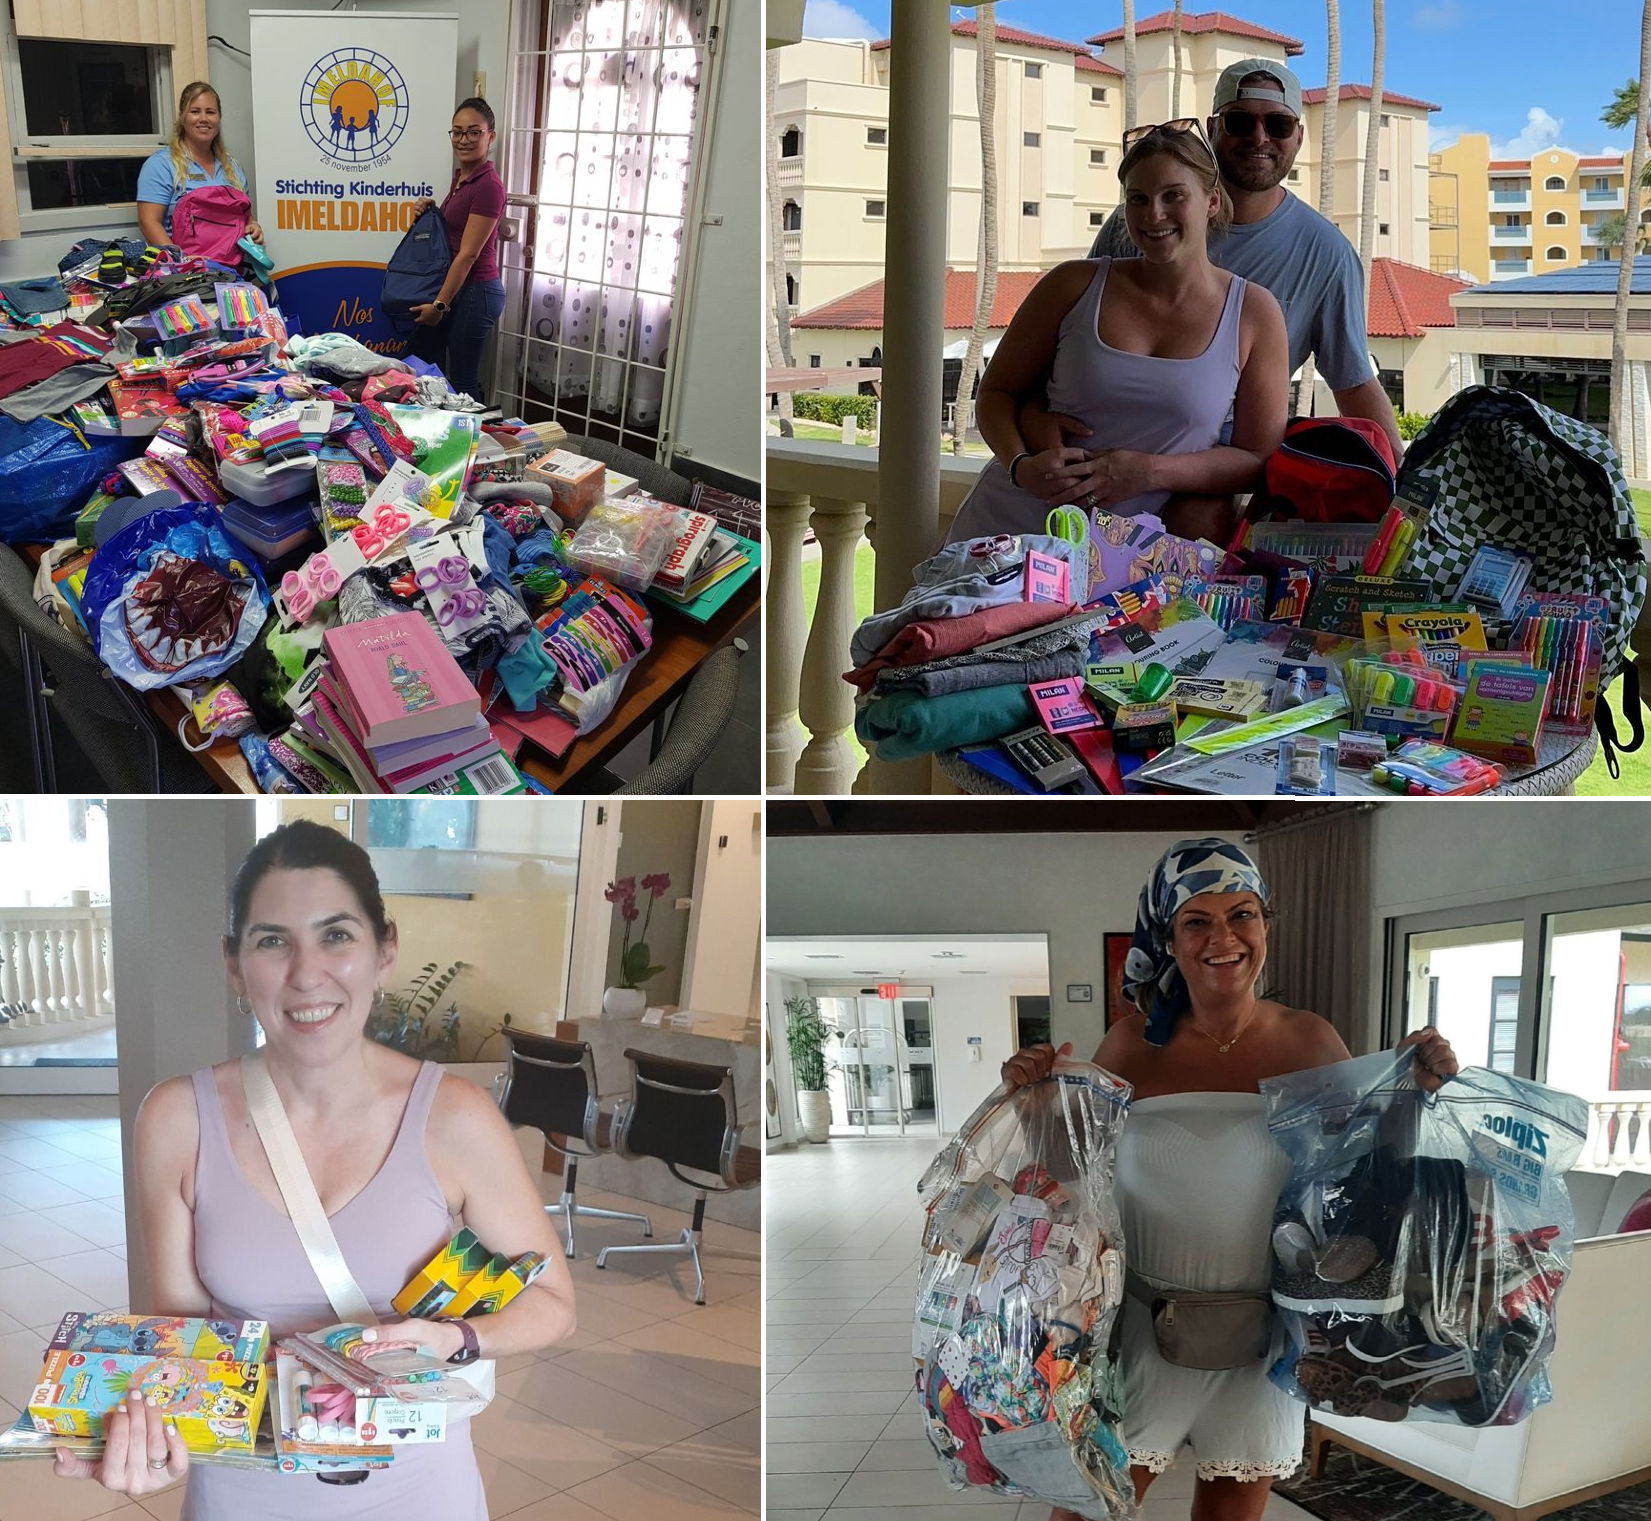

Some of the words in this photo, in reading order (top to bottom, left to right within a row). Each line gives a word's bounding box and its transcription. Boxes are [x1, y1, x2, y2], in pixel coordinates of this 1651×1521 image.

[313, 60, 396, 108] IMELDAHOF
[319, 154, 331, 167] 25
[331, 159, 372, 173] november
[373, 153, 393, 170] 1954
[275, 180, 344, 199] Stichting
[349, 181, 433, 198] Kinderhuis
[276, 199, 415, 232] IMELDAHO
[332, 296, 374, 328] Nos
[664, 514, 706, 571] spirograph
[1035, 560, 1056, 574] MILAN
[1324, 584, 1360, 594] Scratch
[1362, 586, 1381, 596] and
[1382, 588, 1416, 599] Sketch
[1404, 617, 1463, 629] Crayola
[357, 629, 412, 648] Matilda
[1134, 651, 1160, 664] OURING
[1160, 639, 1180, 652] BOOK
[1040, 686, 1067, 697] MILAN
[1493, 682, 1517, 690] tafels
[1210, 768, 1245, 780] Letter
[879, 984, 898, 999] EXIT
[247, 1322, 261, 1334] 24
[46, 1352, 61, 1377] PUZZLE
[34, 1388, 49, 1405] 100
[408, 1410, 422, 1423] 12
[426, 1428, 441, 1439] Jot
